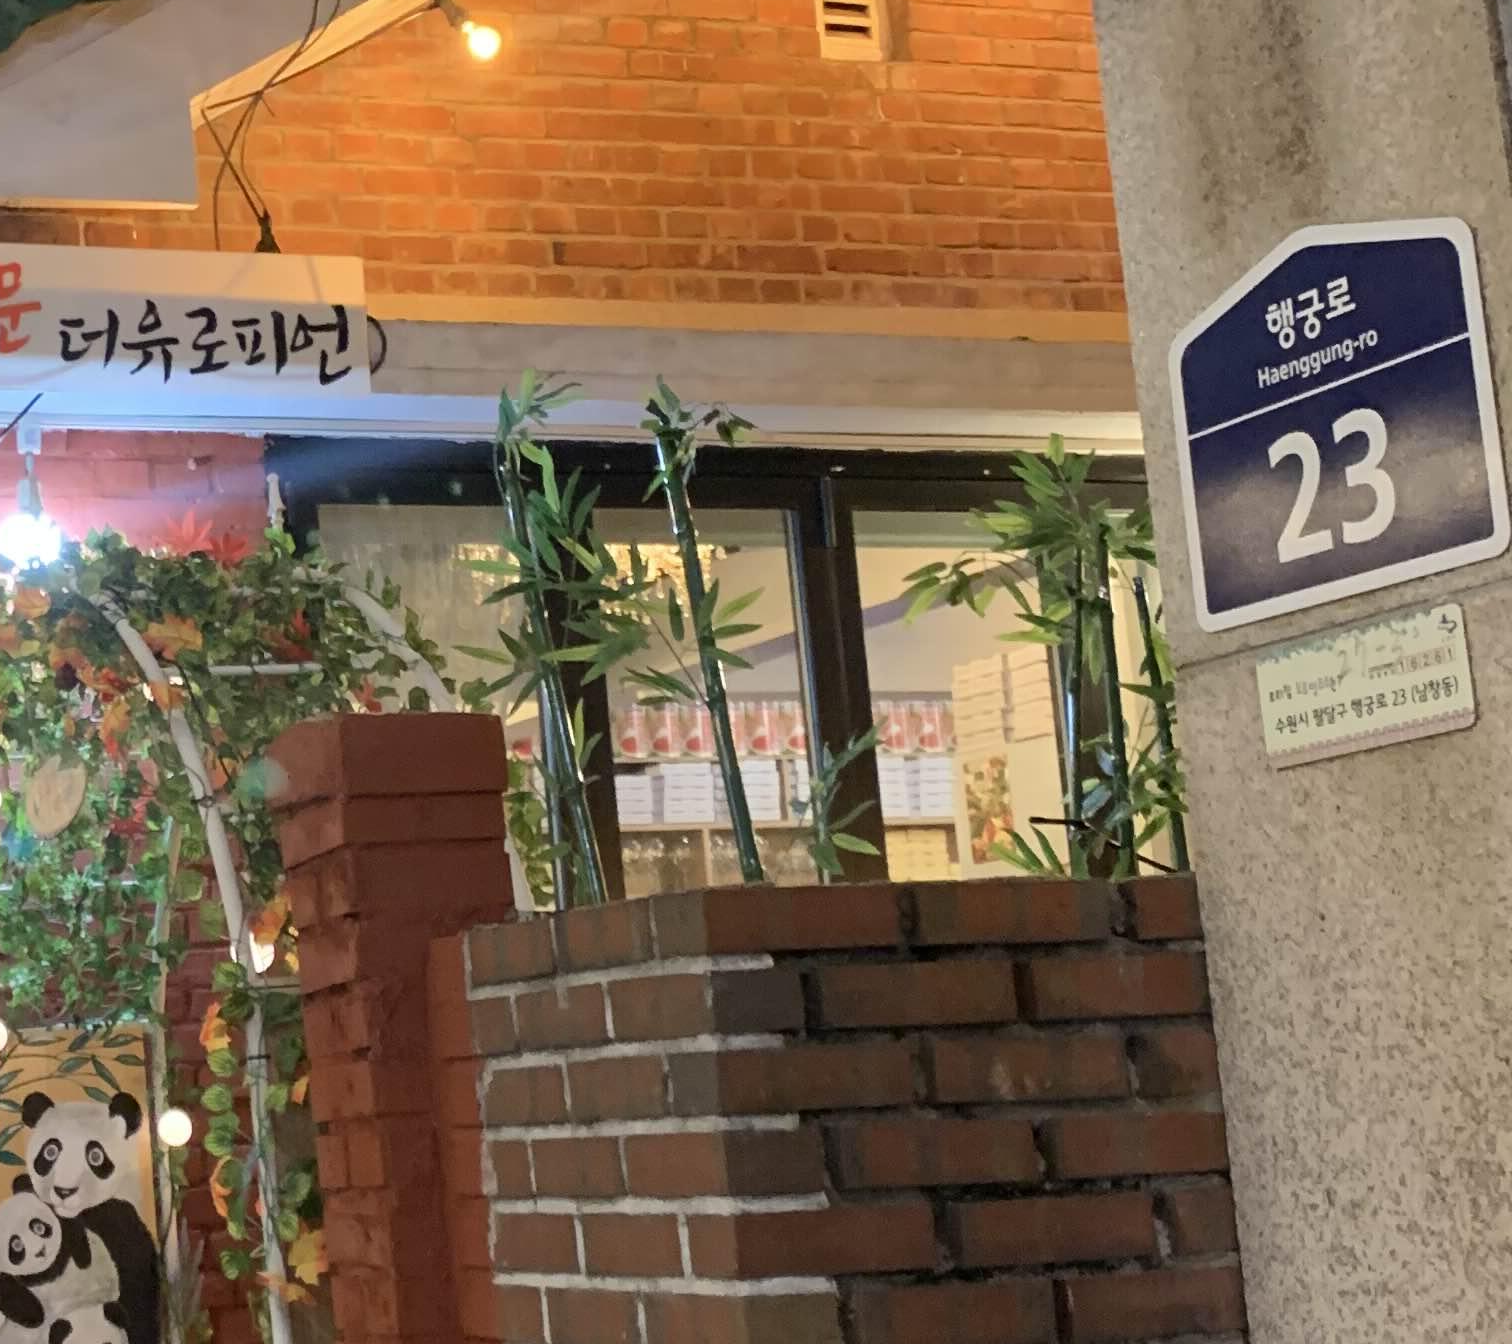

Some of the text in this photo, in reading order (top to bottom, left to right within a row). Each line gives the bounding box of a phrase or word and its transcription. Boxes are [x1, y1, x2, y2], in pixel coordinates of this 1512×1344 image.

[59, 299, 354, 385] 더유로피언
[1265, 276, 1356, 349] 행궁로
[1257, 327, 1379, 389] Haenggung-ro
[1267, 407, 1396, 563] 23
[1275, 675, 1458, 734] 수원시 팔달구 행궁로 23 (남창동)
